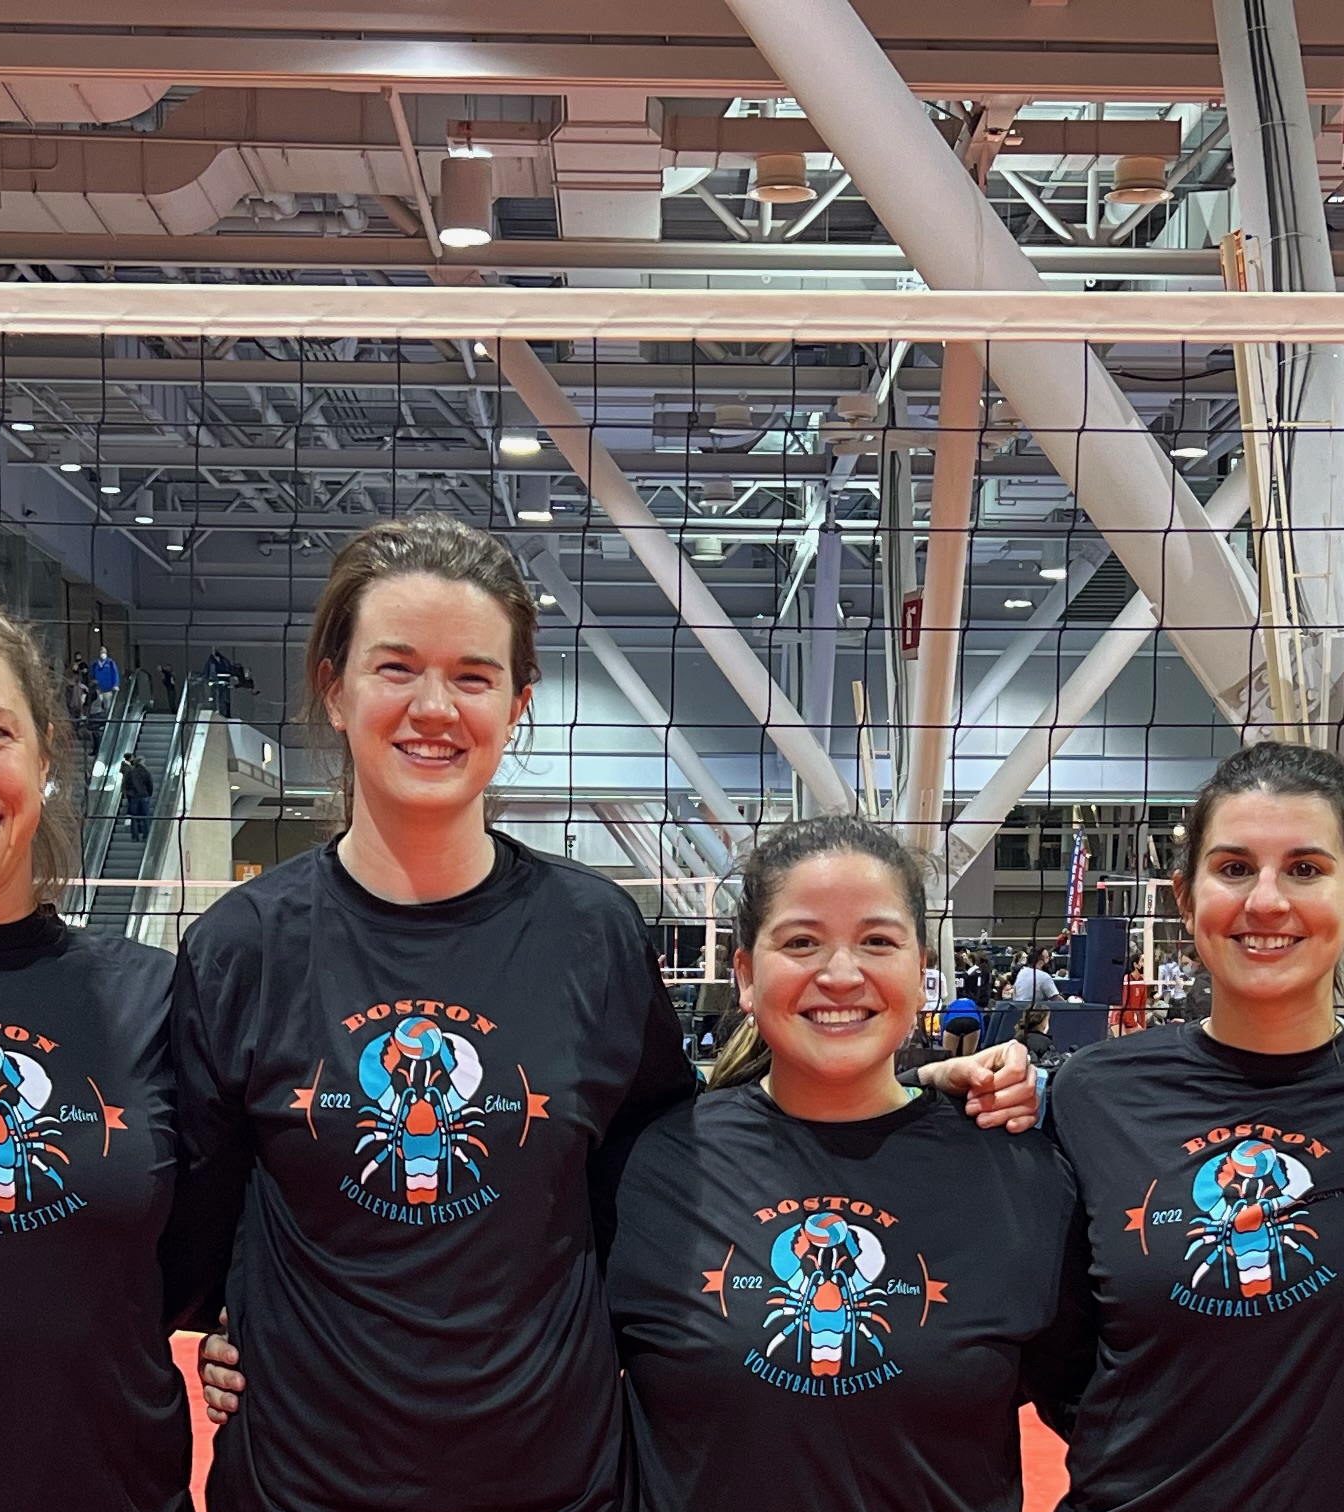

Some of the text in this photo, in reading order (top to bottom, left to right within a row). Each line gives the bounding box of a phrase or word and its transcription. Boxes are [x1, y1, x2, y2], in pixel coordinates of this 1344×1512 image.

[341, 999, 498, 1035] BOSTON
[320, 1093, 351, 1109] 2022
[1181, 1123, 1331, 1159] BOSTON
[9, 1192, 88, 1234] FESTIVAL
[339, 1175, 501, 1226] VOLLEYBALL FESTIVAL
[753, 1195, 899, 1229] BOSTON
[1152, 1208, 1183, 1226] 2022
[732, 1275, 763, 1290] 2022
[1169, 1265, 1338, 1317] VOLLEYBALL FESTIVAL
[743, 1348, 903, 1397] VOLLEYBALL FESTIVAL
